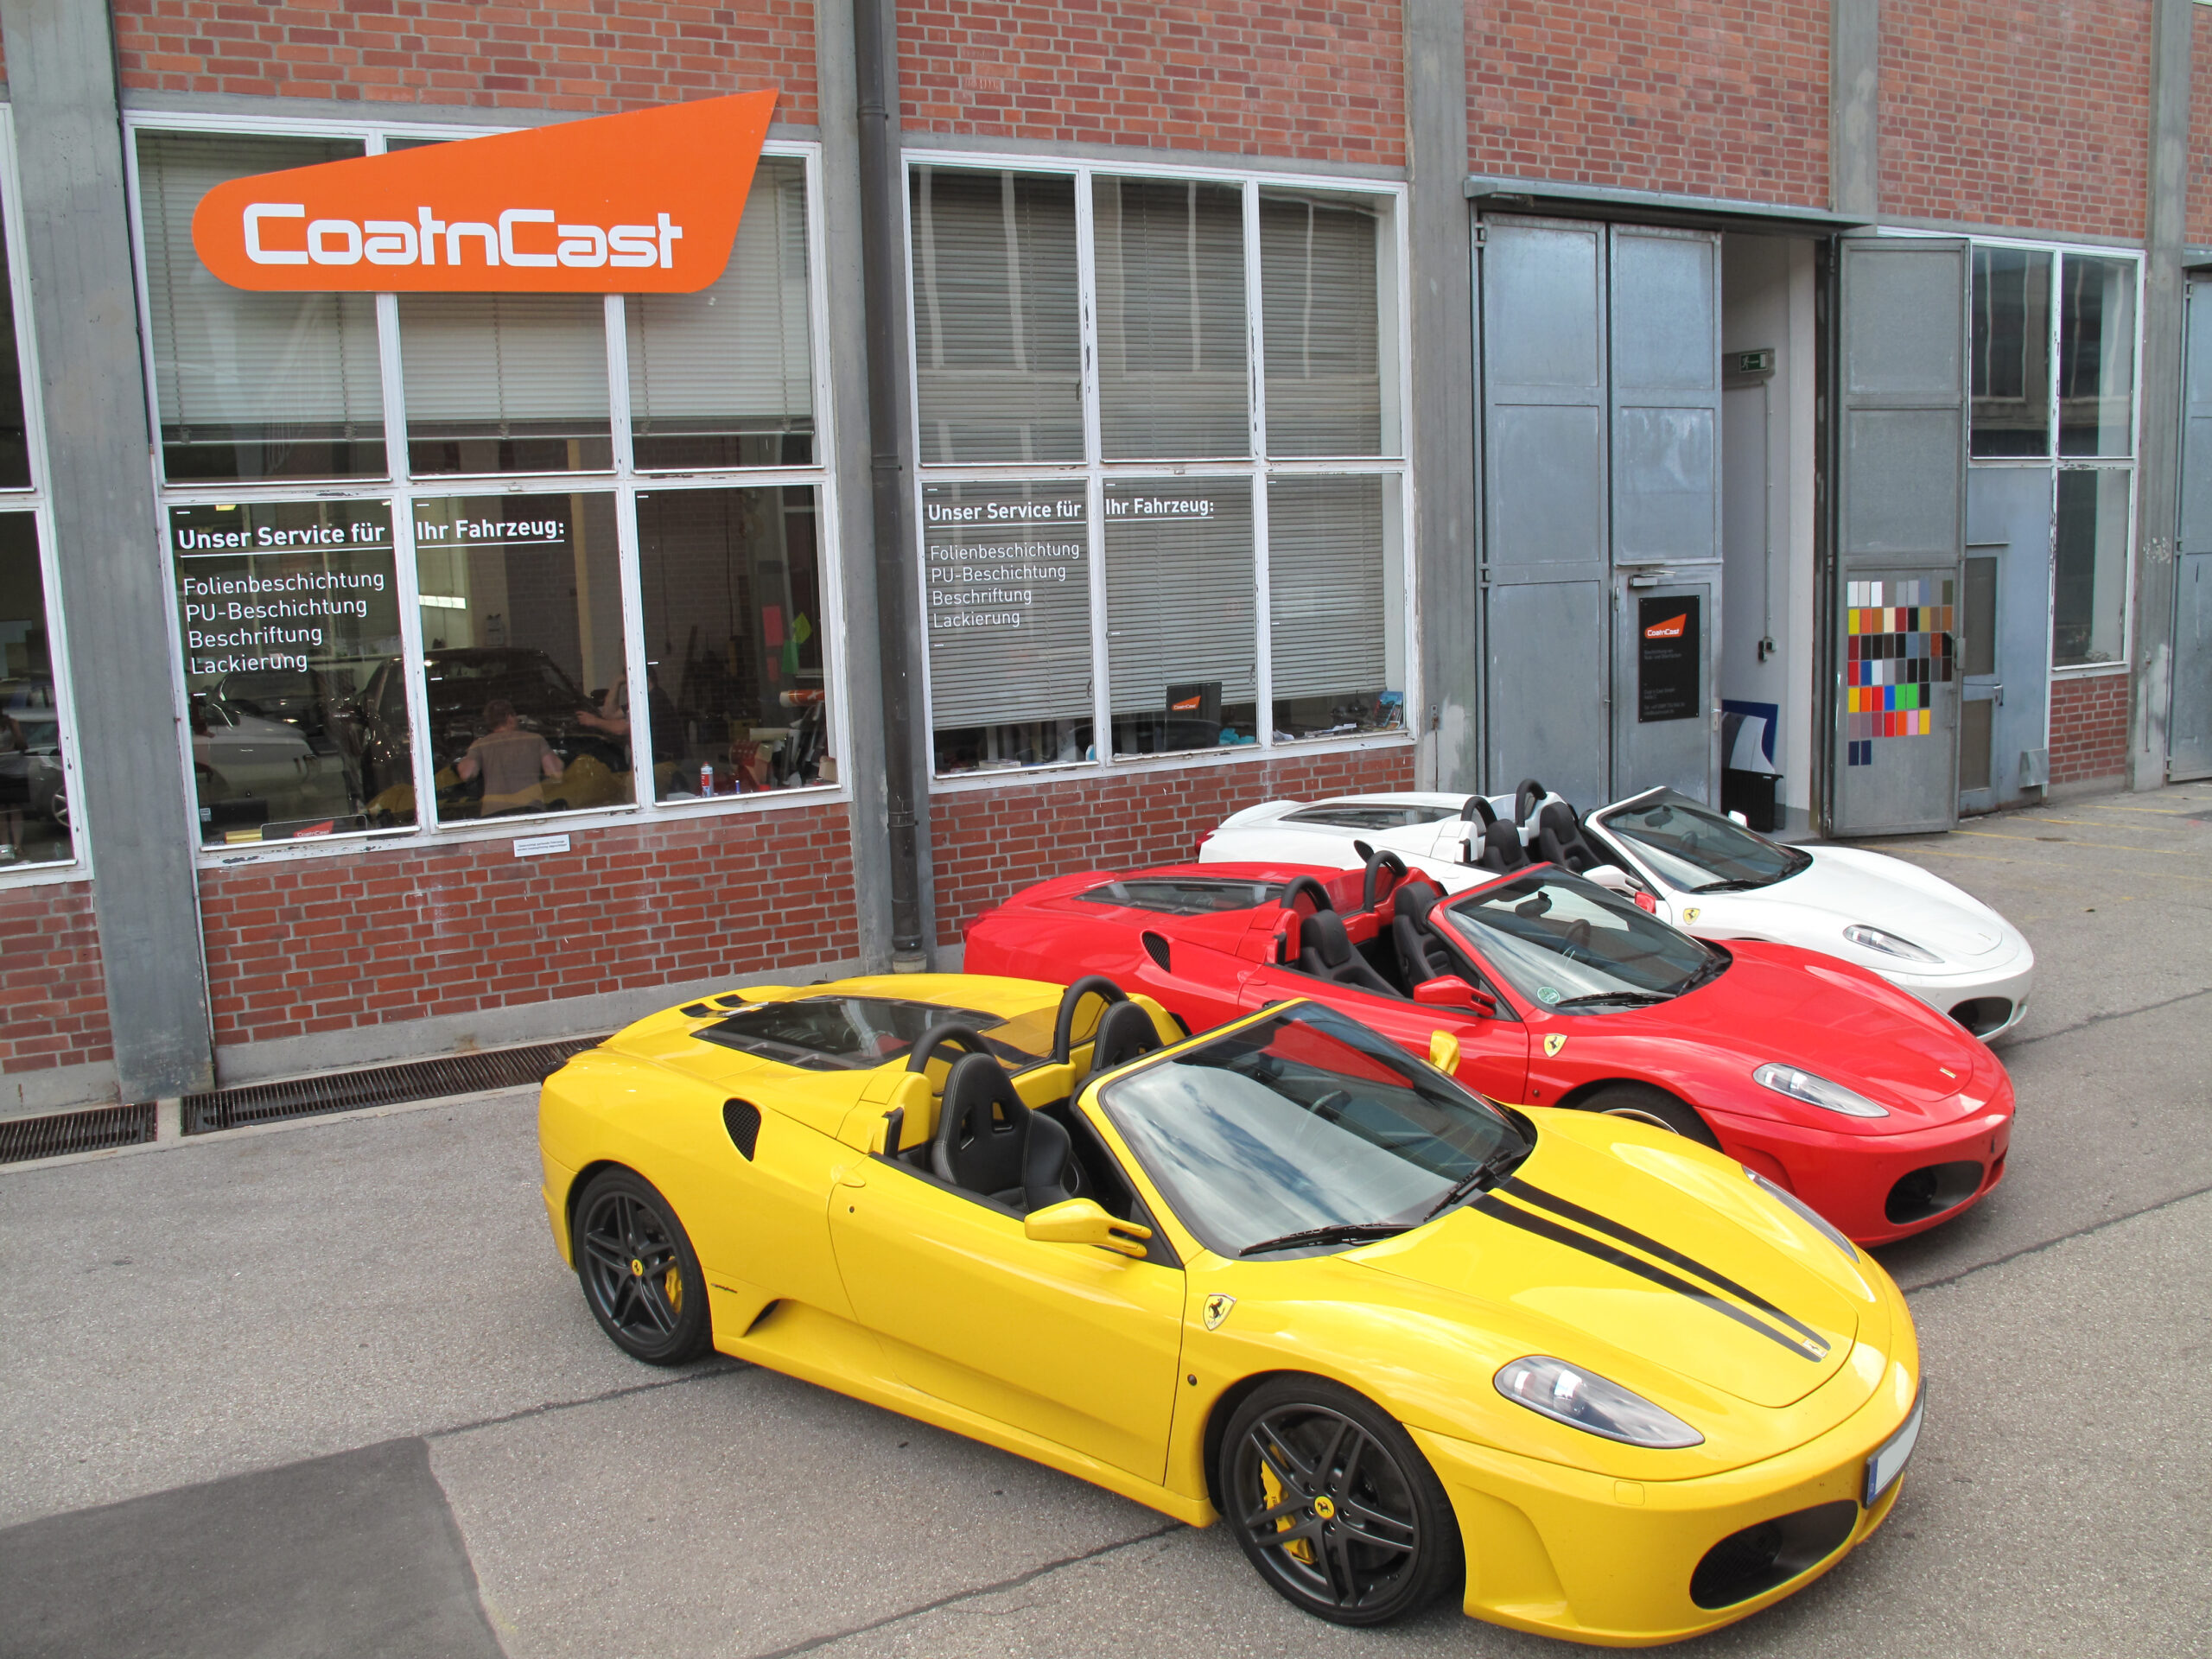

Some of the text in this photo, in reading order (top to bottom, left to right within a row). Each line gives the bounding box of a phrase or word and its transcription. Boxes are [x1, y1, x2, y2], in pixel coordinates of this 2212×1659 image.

[243, 203, 683, 269] CoatnCast
[928, 498, 1214, 521] Unser Service für Ihr Fahrzeug:
[178, 519, 565, 550] Unser Service für Ihr Fahrzeug:
[931, 542, 1079, 561] Folienbeschichtung
[183, 572, 385, 596] Folienbeschichtung
[931, 564, 1066, 582] PU-Beschichtung
[932, 588, 1032, 606] Beschriftung
[186, 598, 367, 623] PU-Beschichtung
[933, 610, 1020, 628] Lackierung
[189, 626, 323, 649] Beschriftung
[191, 653, 308, 675] Lackierung
